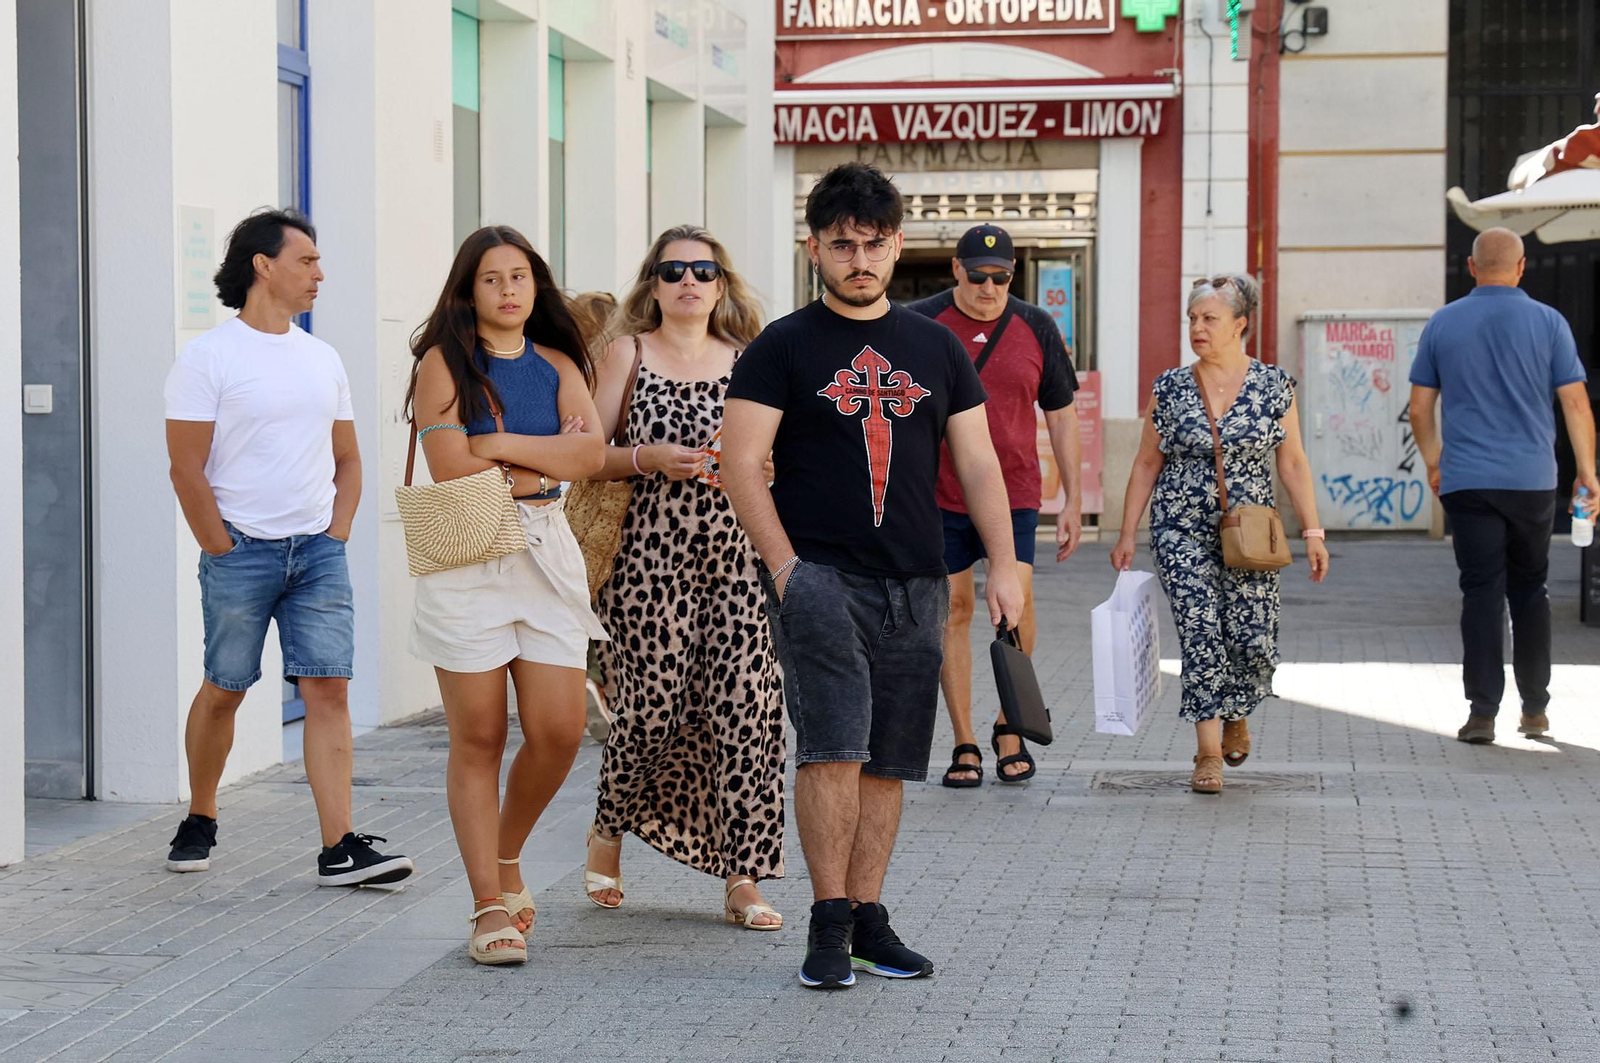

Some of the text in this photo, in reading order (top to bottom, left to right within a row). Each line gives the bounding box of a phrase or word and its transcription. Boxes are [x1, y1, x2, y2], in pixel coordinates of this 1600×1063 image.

[783, 0, 921, 28] FARMACIA
[945, 0, 1104, 25] ORTOPEDIA
[774, 105, 878, 142] MACIA
[892, 103, 1037, 140] VAZQUEZ
[1063, 100, 1163, 136] LIMON
[855, 140, 1041, 166] FARMACIA
[1326, 322, 1377, 342] MARCA
